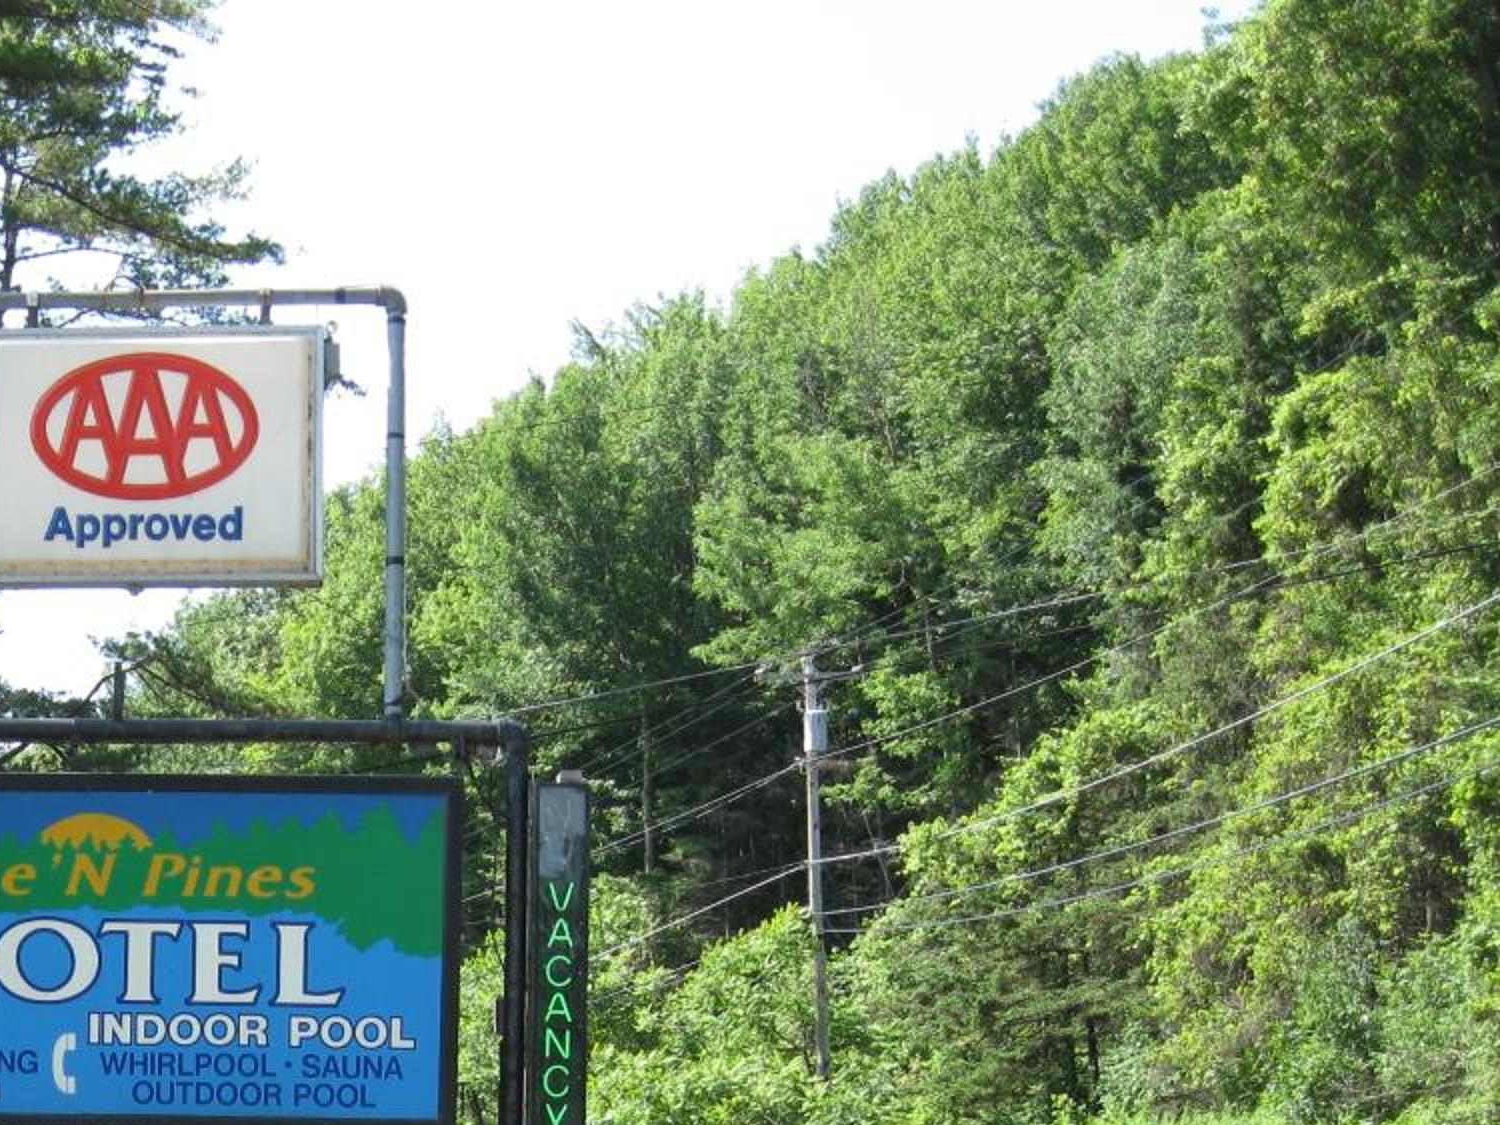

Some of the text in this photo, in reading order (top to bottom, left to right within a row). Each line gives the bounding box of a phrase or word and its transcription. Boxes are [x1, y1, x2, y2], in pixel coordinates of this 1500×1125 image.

[42, 354, 248, 496] AAA
[43, 506, 243, 548] Approved
[141, 854, 317, 899] Pines
[88, 1013, 417, 1051] INDOOR POOL
[100, 1052, 404, 1079] WHIRLPOOL SAUNA
[131, 1081, 377, 1108] OUTDOOR POOL
